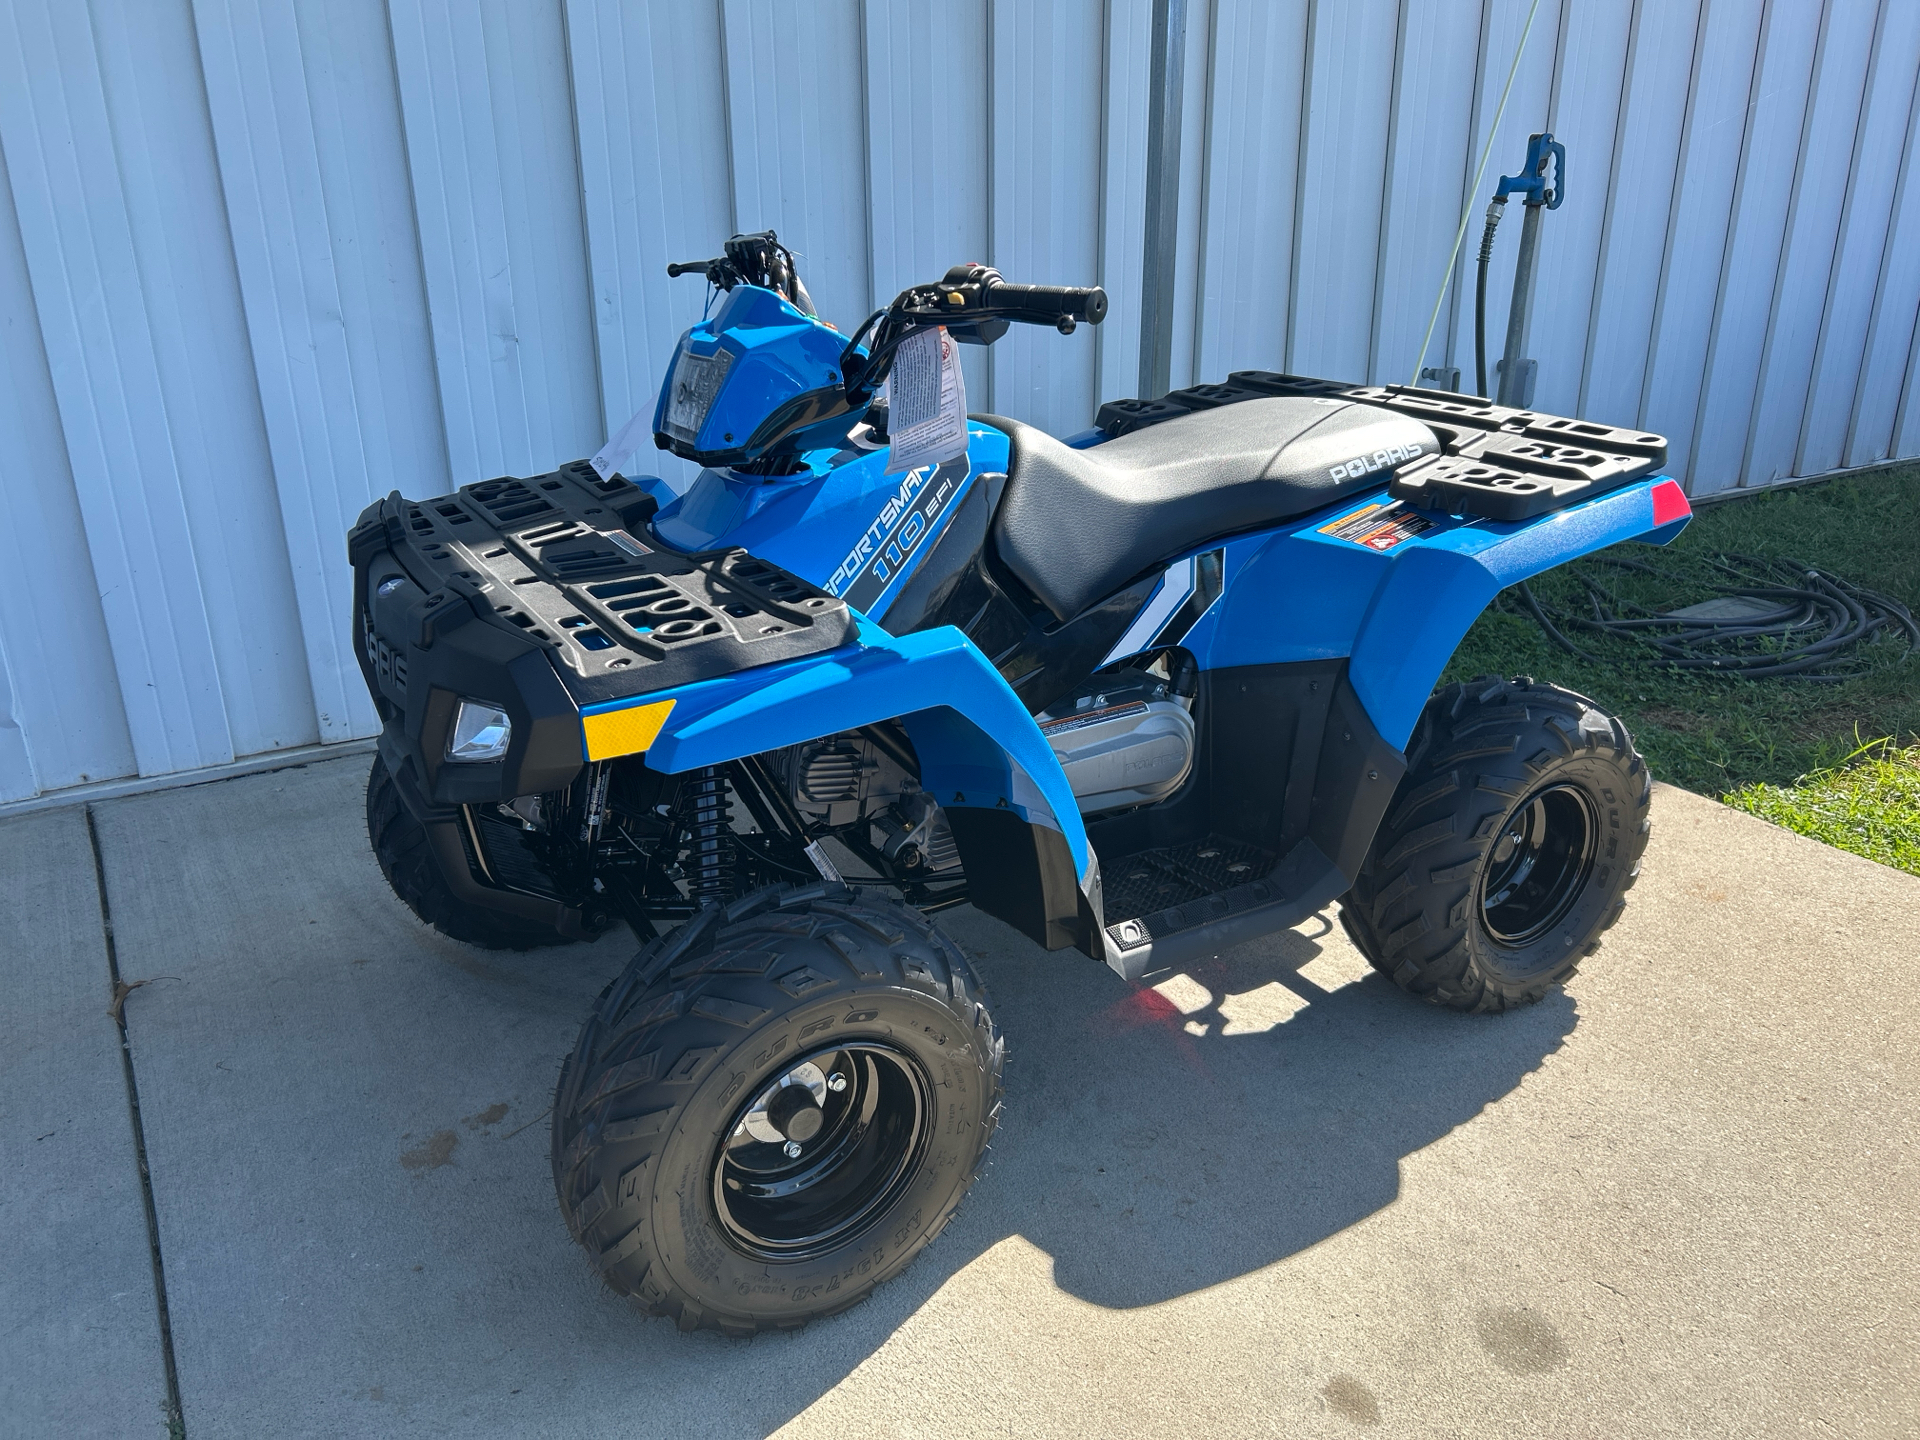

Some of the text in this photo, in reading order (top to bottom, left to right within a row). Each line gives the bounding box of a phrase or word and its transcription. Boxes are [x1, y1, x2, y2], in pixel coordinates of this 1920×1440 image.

[1329, 443, 1422, 485] POLARIS
[872, 510, 925, 583] 110
[925, 478, 952, 518] EFI
[363, 604, 407, 695] ARIS
[1596, 787, 1620, 889] DURO
[717, 1009, 880, 1109] DURO
